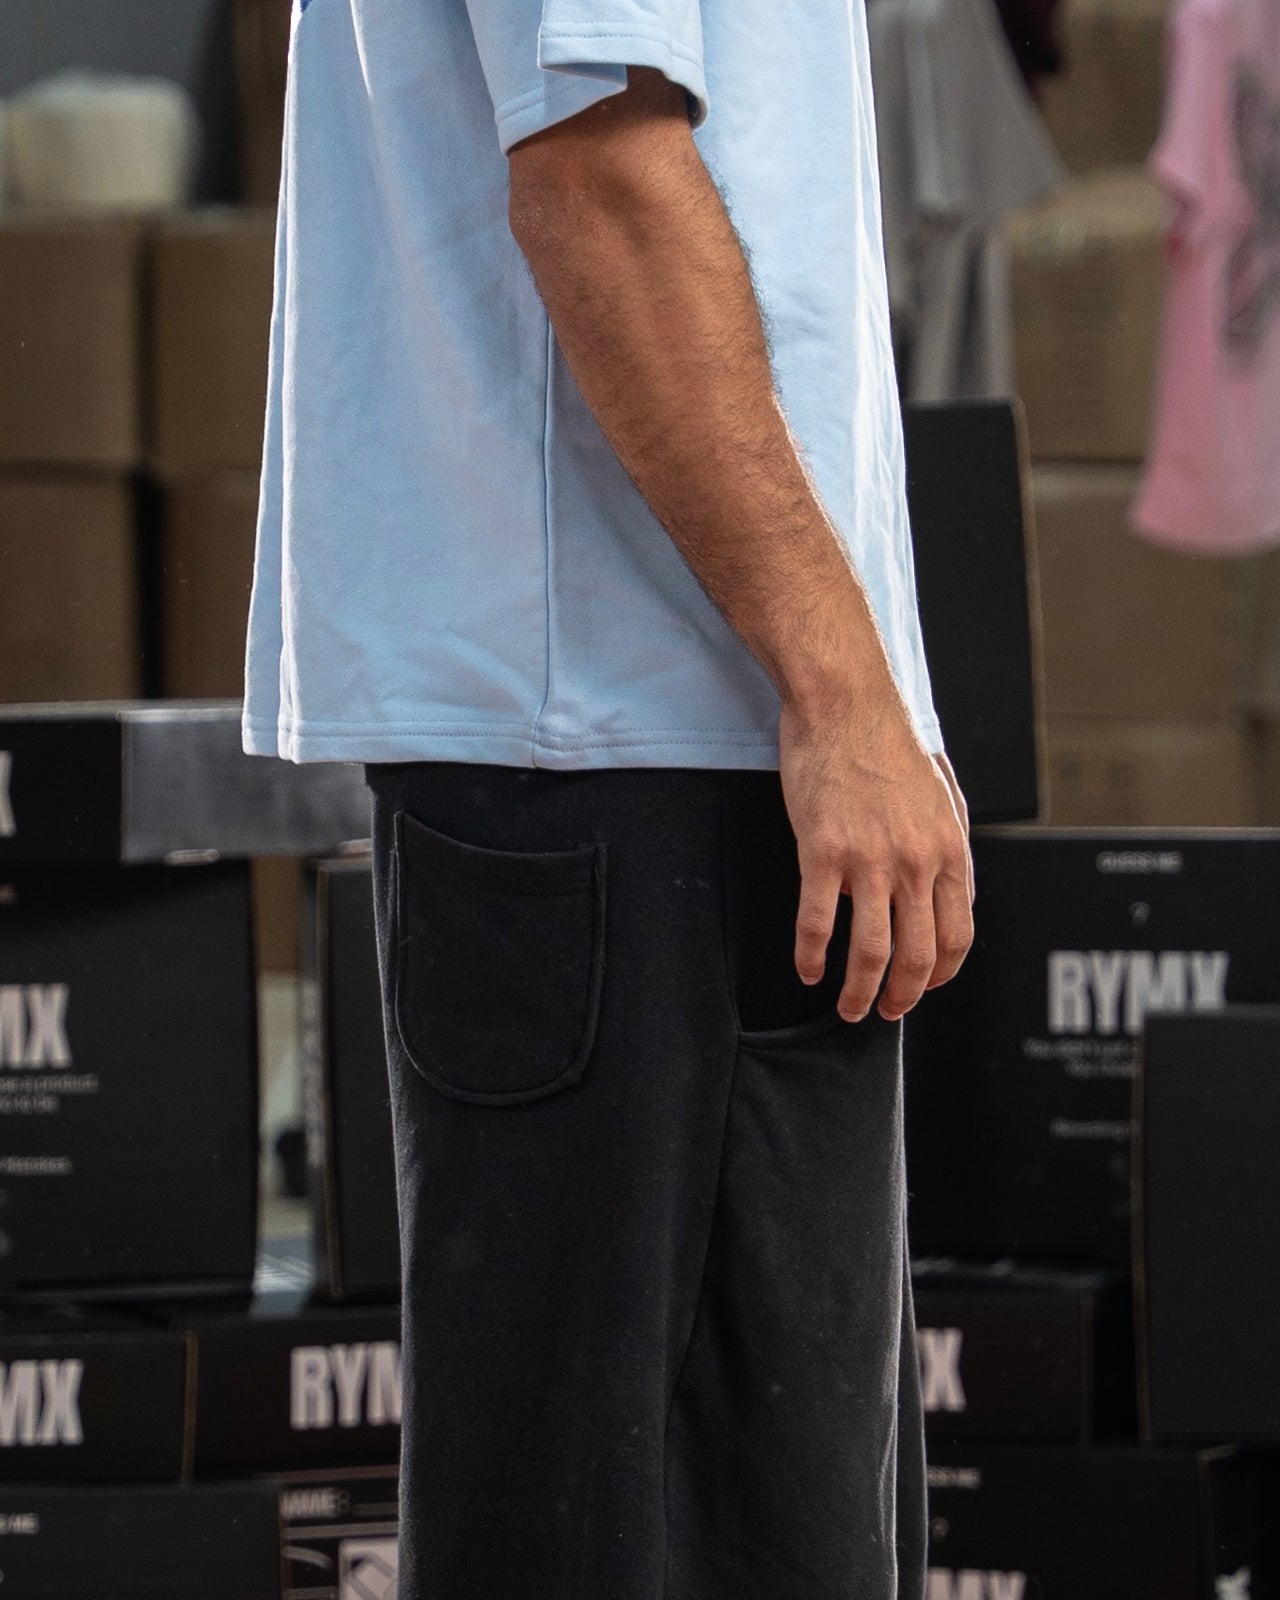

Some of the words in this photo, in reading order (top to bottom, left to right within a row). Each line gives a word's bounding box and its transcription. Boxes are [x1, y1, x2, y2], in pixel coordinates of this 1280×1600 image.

[1048, 950, 1228, 1035] RYMX
[291, 1341, 402, 1429] RYM
[8, 1512, 40, 1535] ME
